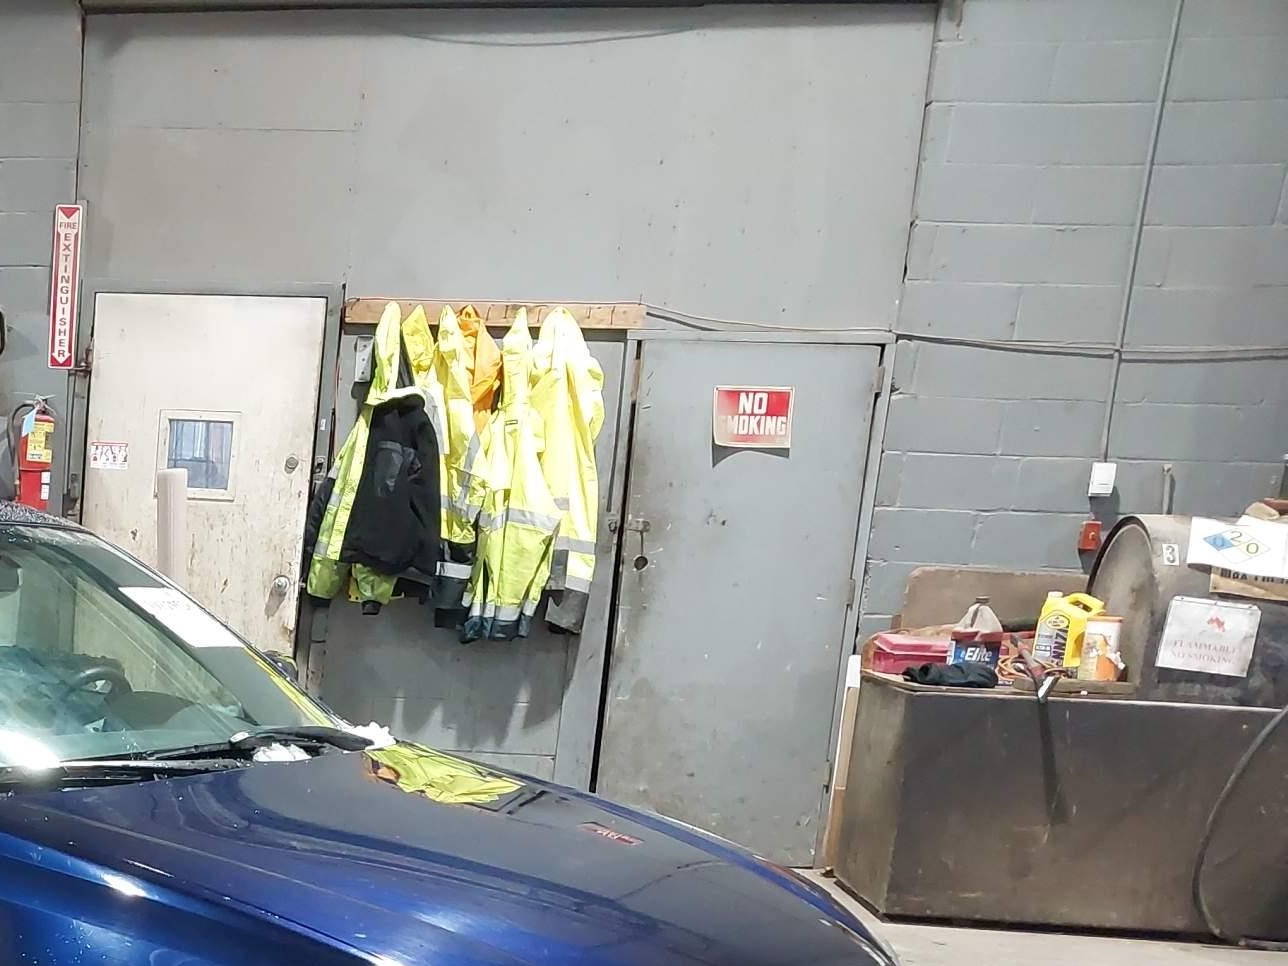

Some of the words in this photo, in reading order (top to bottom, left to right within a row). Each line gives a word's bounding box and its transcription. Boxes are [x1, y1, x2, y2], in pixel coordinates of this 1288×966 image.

[59, 221, 77, 230] FIRE
[57, 232, 72, 358] EXTINGUISHER
[738, 391, 769, 415] NO
[722, 415, 788, 436] MOKING
[1165, 545, 1176, 564] 3
